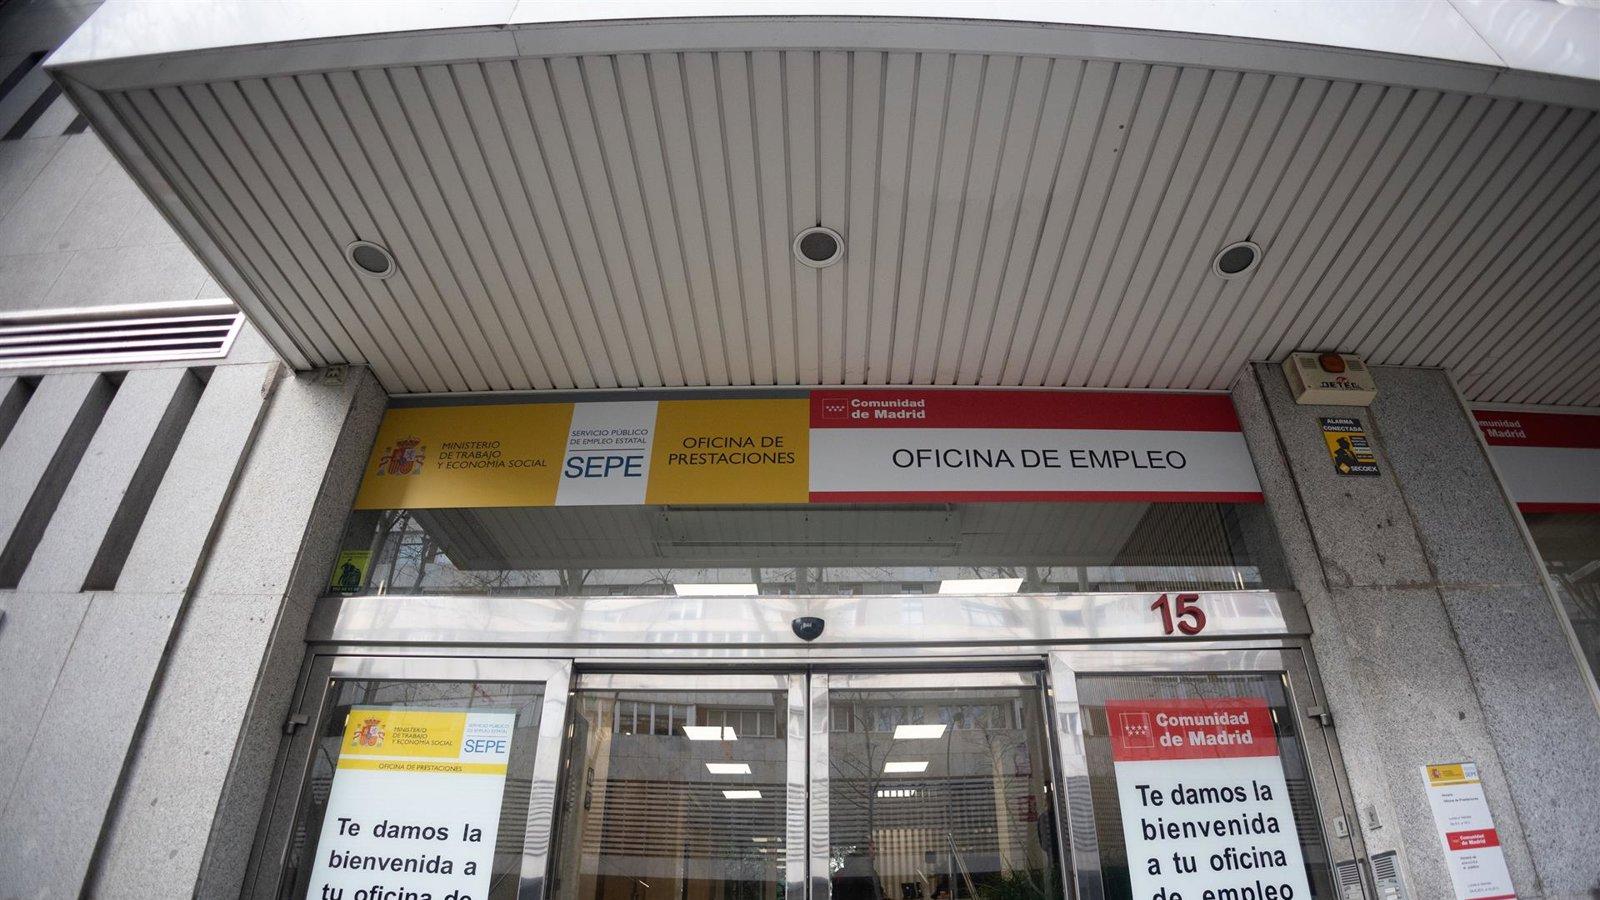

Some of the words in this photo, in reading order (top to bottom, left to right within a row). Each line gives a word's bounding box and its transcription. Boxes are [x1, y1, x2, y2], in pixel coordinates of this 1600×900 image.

[851, 398, 926, 408] Comunidad
[851, 409, 870, 419] de
[874, 409, 926, 419] Madrid
[1479, 419, 1521, 428] munidad
[571, 429, 609, 437] SERVICIO
[611, 427, 649, 436] PÚBLICO
[1487, 428, 1527, 439] Madrid
[441, 440, 501, 450] MINISTERIO
[570, 438, 580, 446] DE
[582, 438, 614, 446] EMPLEO
[616, 437, 648, 445] ESTATAL
[682, 436, 756, 449] OFICINA
[761, 436, 784, 448] DE
[440, 451, 454, 460] DE
[456, 450, 502, 461] TRABAJO
[668, 452, 796, 465] PRESTACIONES
[891, 448, 1016, 469] OFICINA
[1021, 448, 1062, 469] DE
[1069, 449, 1188, 470] EMPLEO
[437, 461, 444, 470] Y
[508, 459, 548, 468] SOCIAL
[564, 455, 644, 479] SEPE
[1150, 592, 1208, 636] 15
[1155, 711, 1250, 728] Comunidad
[1160, 731, 1184, 747] de
[1188, 729, 1254, 746] Madrid
[463, 739, 507, 754] SEPE
[416, 764, 463, 773] PRESTACIONES
[1135, 784, 1164, 807] Te
[1171, 783, 1248, 806] damos
[1252, 780, 1274, 801] la
[337, 818, 361, 837] Te
[373, 820, 449, 841] damos
[462, 824, 482, 843] la
[1141, 812, 1281, 841] bienvenida
[328, 850, 454, 875] bienvenida
[463, 860, 478, 876] a
[1146, 857, 1162, 876] a
[1172, 852, 1198, 874] tu
[1209, 845, 1287, 872] oficina
[321, 883, 343, 900] tu
[1202, 880, 1295, 900] empleo
